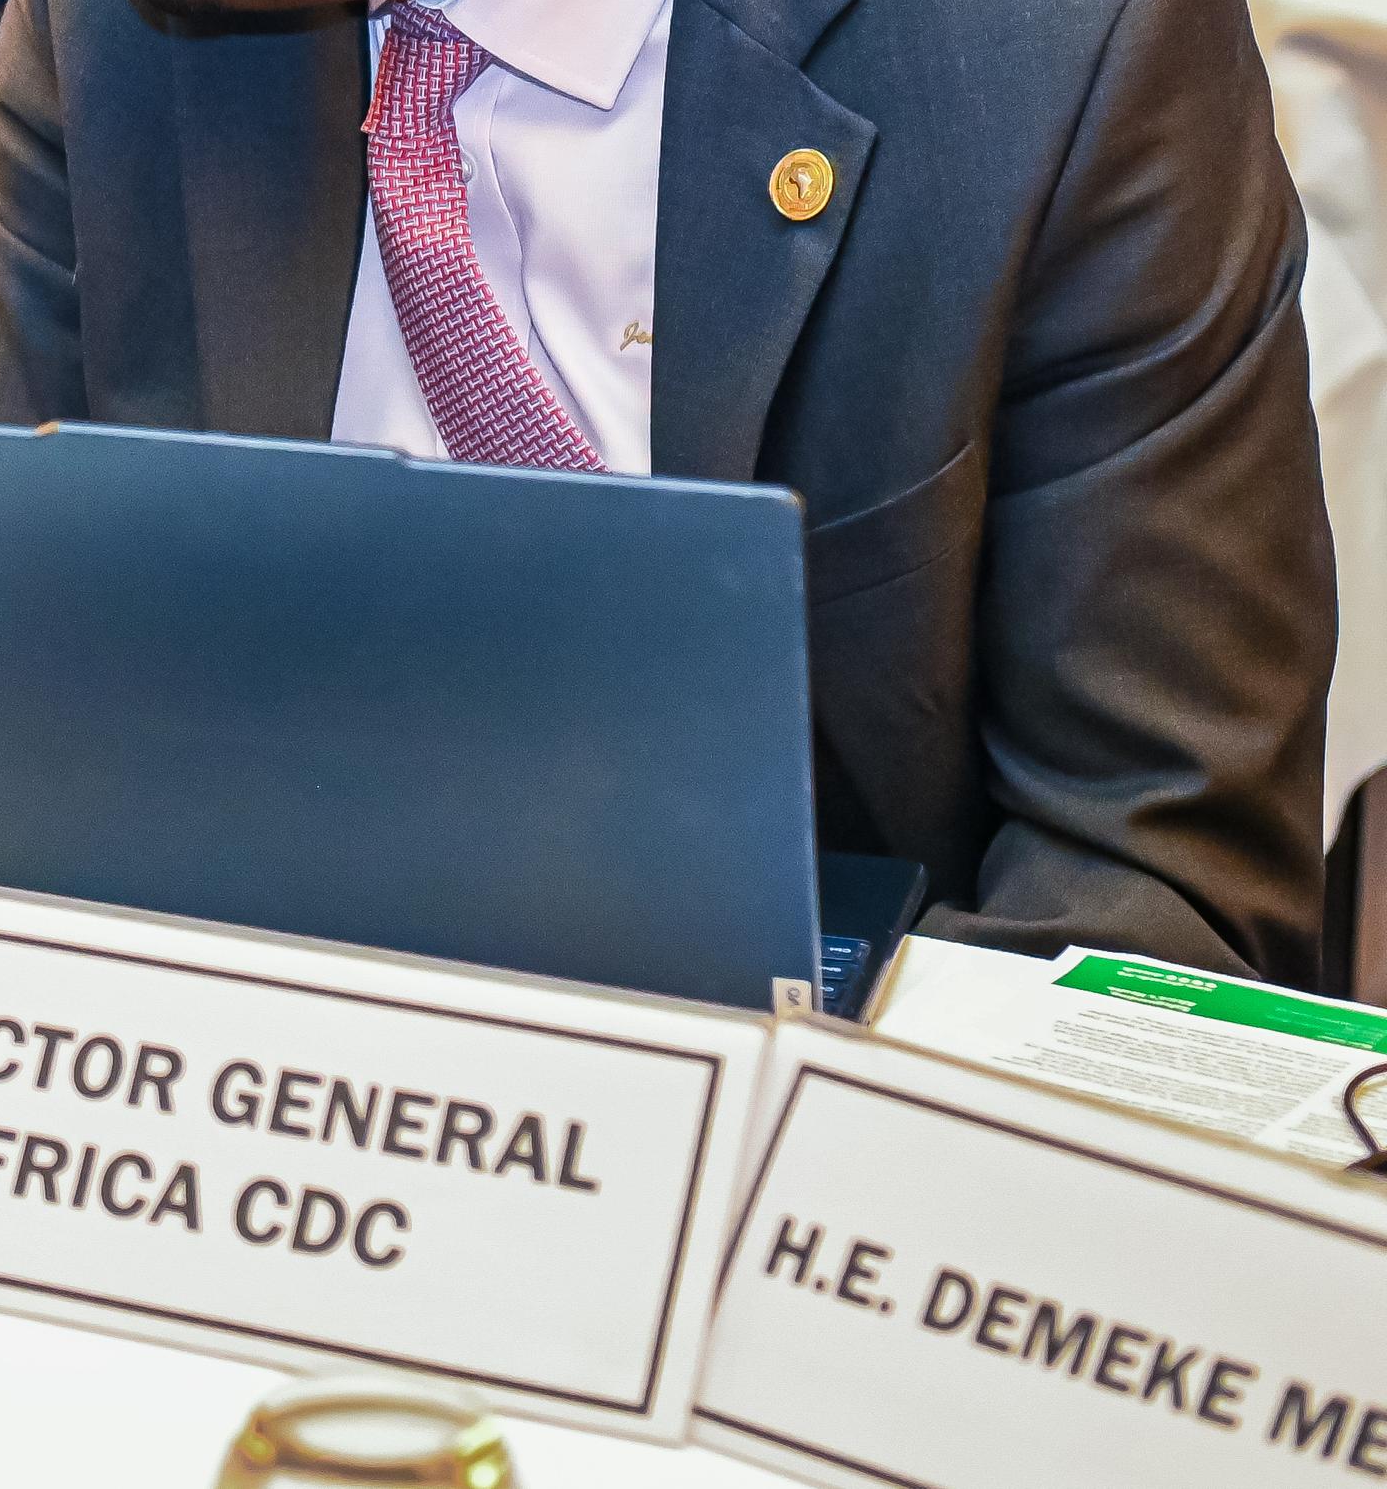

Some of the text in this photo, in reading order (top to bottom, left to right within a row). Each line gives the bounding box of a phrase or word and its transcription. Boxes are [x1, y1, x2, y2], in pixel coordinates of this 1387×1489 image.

[213, 1061, 599, 1191] GENERAL
[235, 1179, 408, 1267] CDC
[765, 1218, 893, 1312] H.E.
[922, 1268, 1256, 1428] DEMEKE
